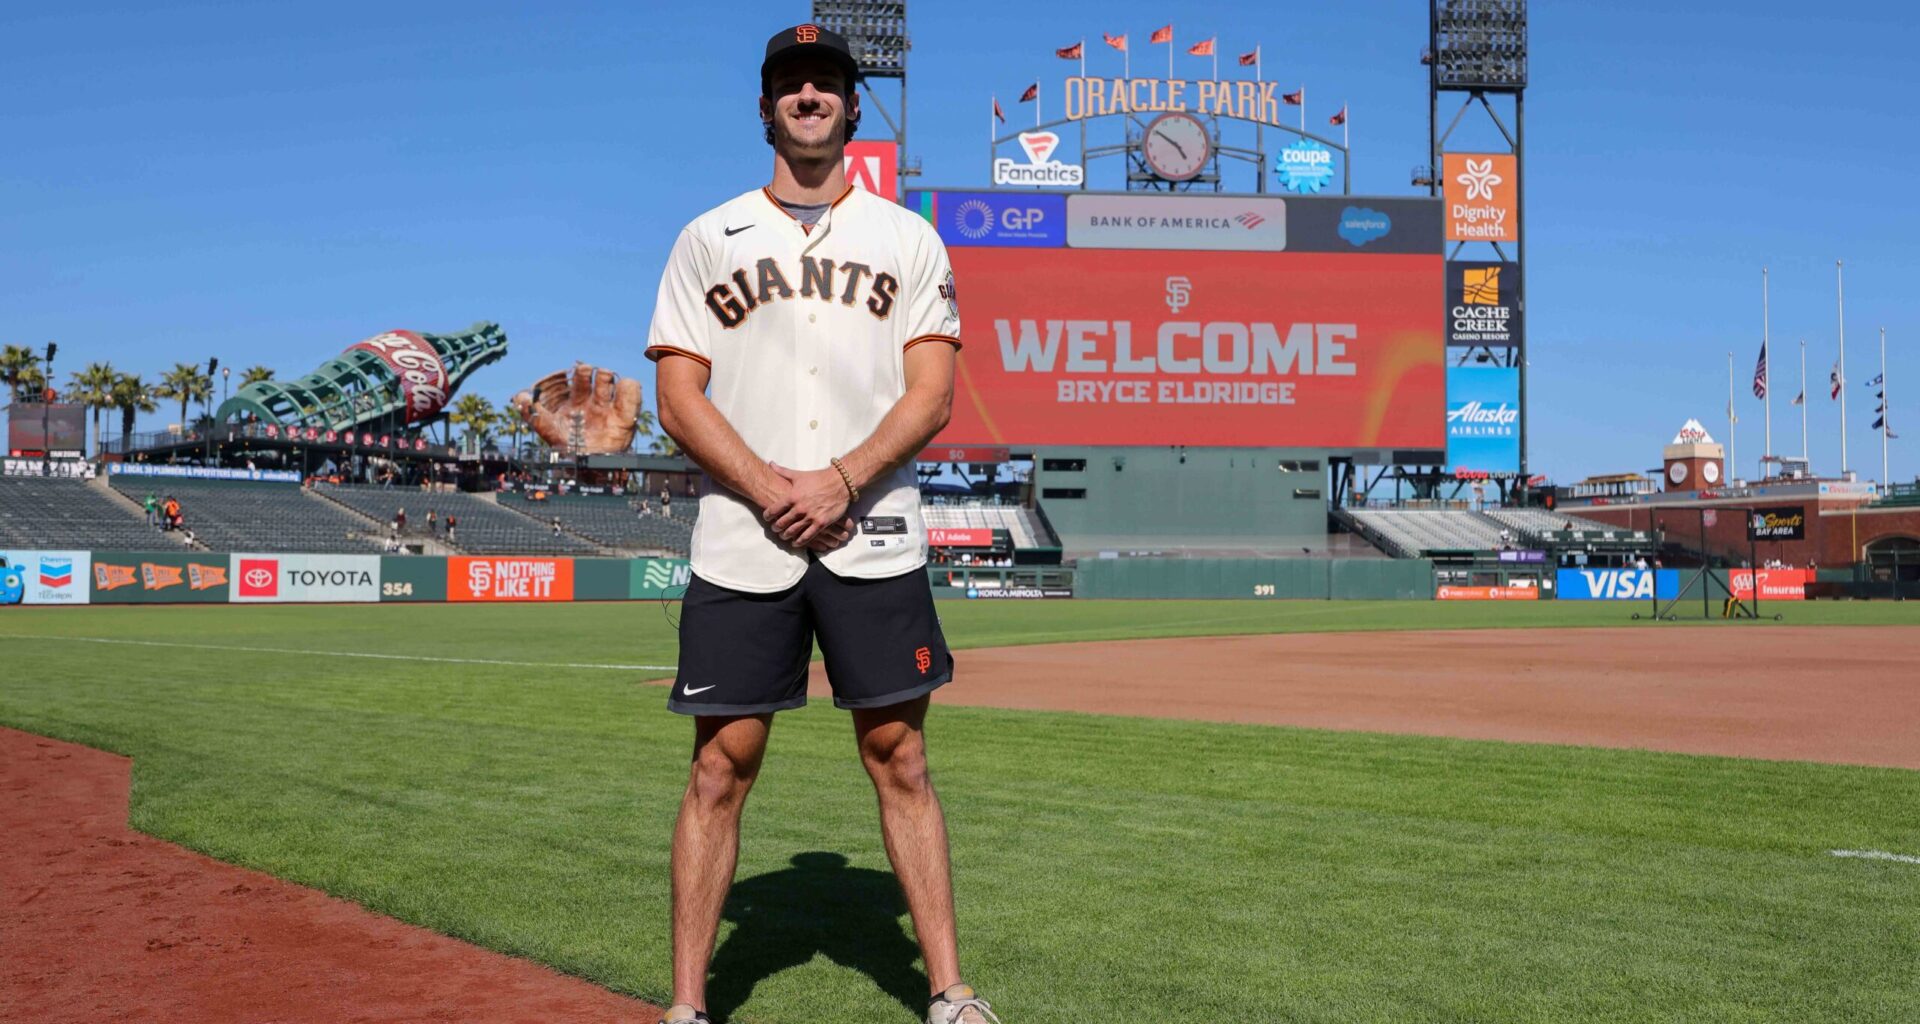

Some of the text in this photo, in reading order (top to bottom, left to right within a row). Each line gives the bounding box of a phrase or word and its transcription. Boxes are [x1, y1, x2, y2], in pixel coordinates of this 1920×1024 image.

[1065, 77, 1280, 126] ORACLE PARK
[1283, 150, 1330, 167] coupa
[998, 162, 1080, 182] Fanatics
[1453, 204, 1506, 224] Dignity
[1090, 216, 1230, 229] BANK OF AMERICA
[1345, 219, 1386, 231] salesforce
[1456, 222, 1505, 237] Health
[704, 255, 899, 330] GIANTS
[1452, 306, 1510, 319] CACHE
[1454, 319, 1508, 331] CREEK
[994, 319, 1358, 376] WELCOME
[1057, 380, 1296, 404] BRYCE ELDRIDGE
[1447, 400, 1518, 426] Alaska
[1451, 426, 1511, 435] AIRLINES
[4, 460, 43, 477] FAN
[1764, 512, 1802, 528] Sports
[947, 533, 971, 541] Adobe
[1756, 527, 1793, 536] BAY AREA
[495, 561, 555, 579] NOTHING
[287, 571, 373, 586] TOYOTA
[495, 575, 555, 597] LIKE IT
[1580, 571, 1654, 598] VISA
[383, 583, 413, 596] 354
[978, 589, 1008, 597] KONICA
[1009, 589, 1043, 597] MINOLTA
[1254, 584, 1275, 596] 391
